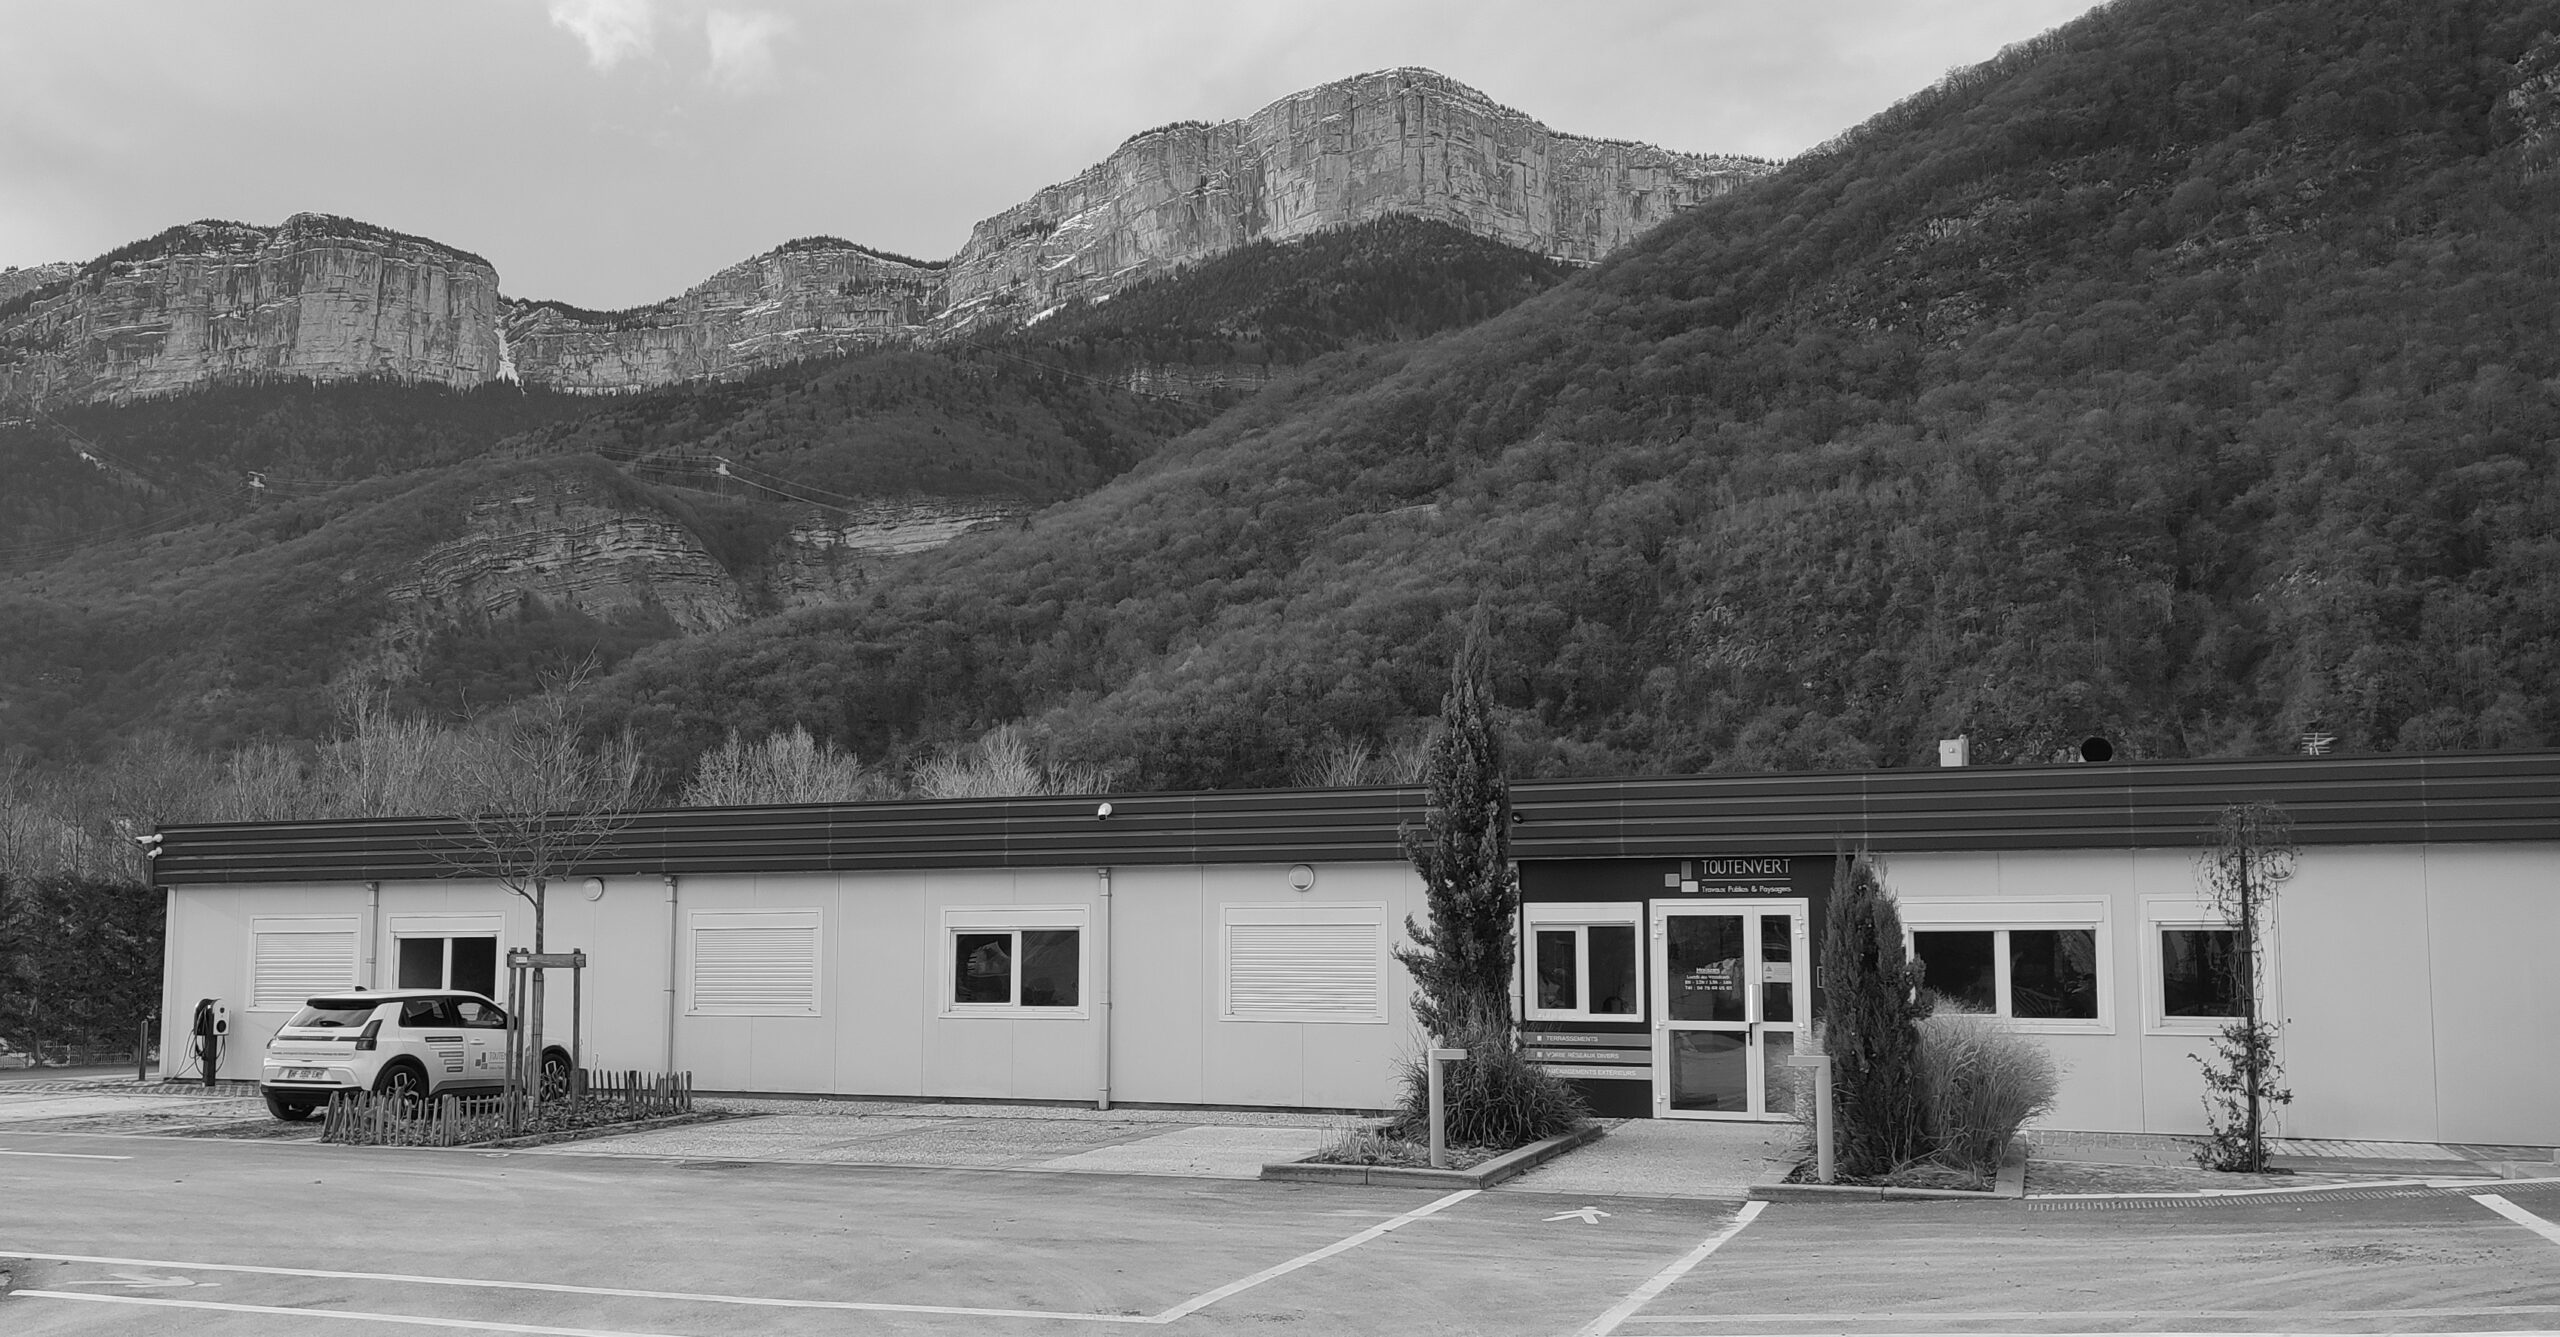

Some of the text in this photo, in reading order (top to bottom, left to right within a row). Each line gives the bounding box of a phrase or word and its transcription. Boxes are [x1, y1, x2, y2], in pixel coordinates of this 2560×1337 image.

[1701, 858, 1791, 874] TOUTENVERT
[1728, 885, 1749, 893] Publics
[1751, 885, 1758, 893] &
[1759, 885, 1792, 894] Paysagers
[1546, 1035, 1599, 1043] TERRASSEMENTS
[1567, 1050, 1596, 1059] RÉSEAUX
[1596, 1052, 1620, 1060] DIVERS
[1597, 1068, 1638, 1077] EXTÉRIEURS
